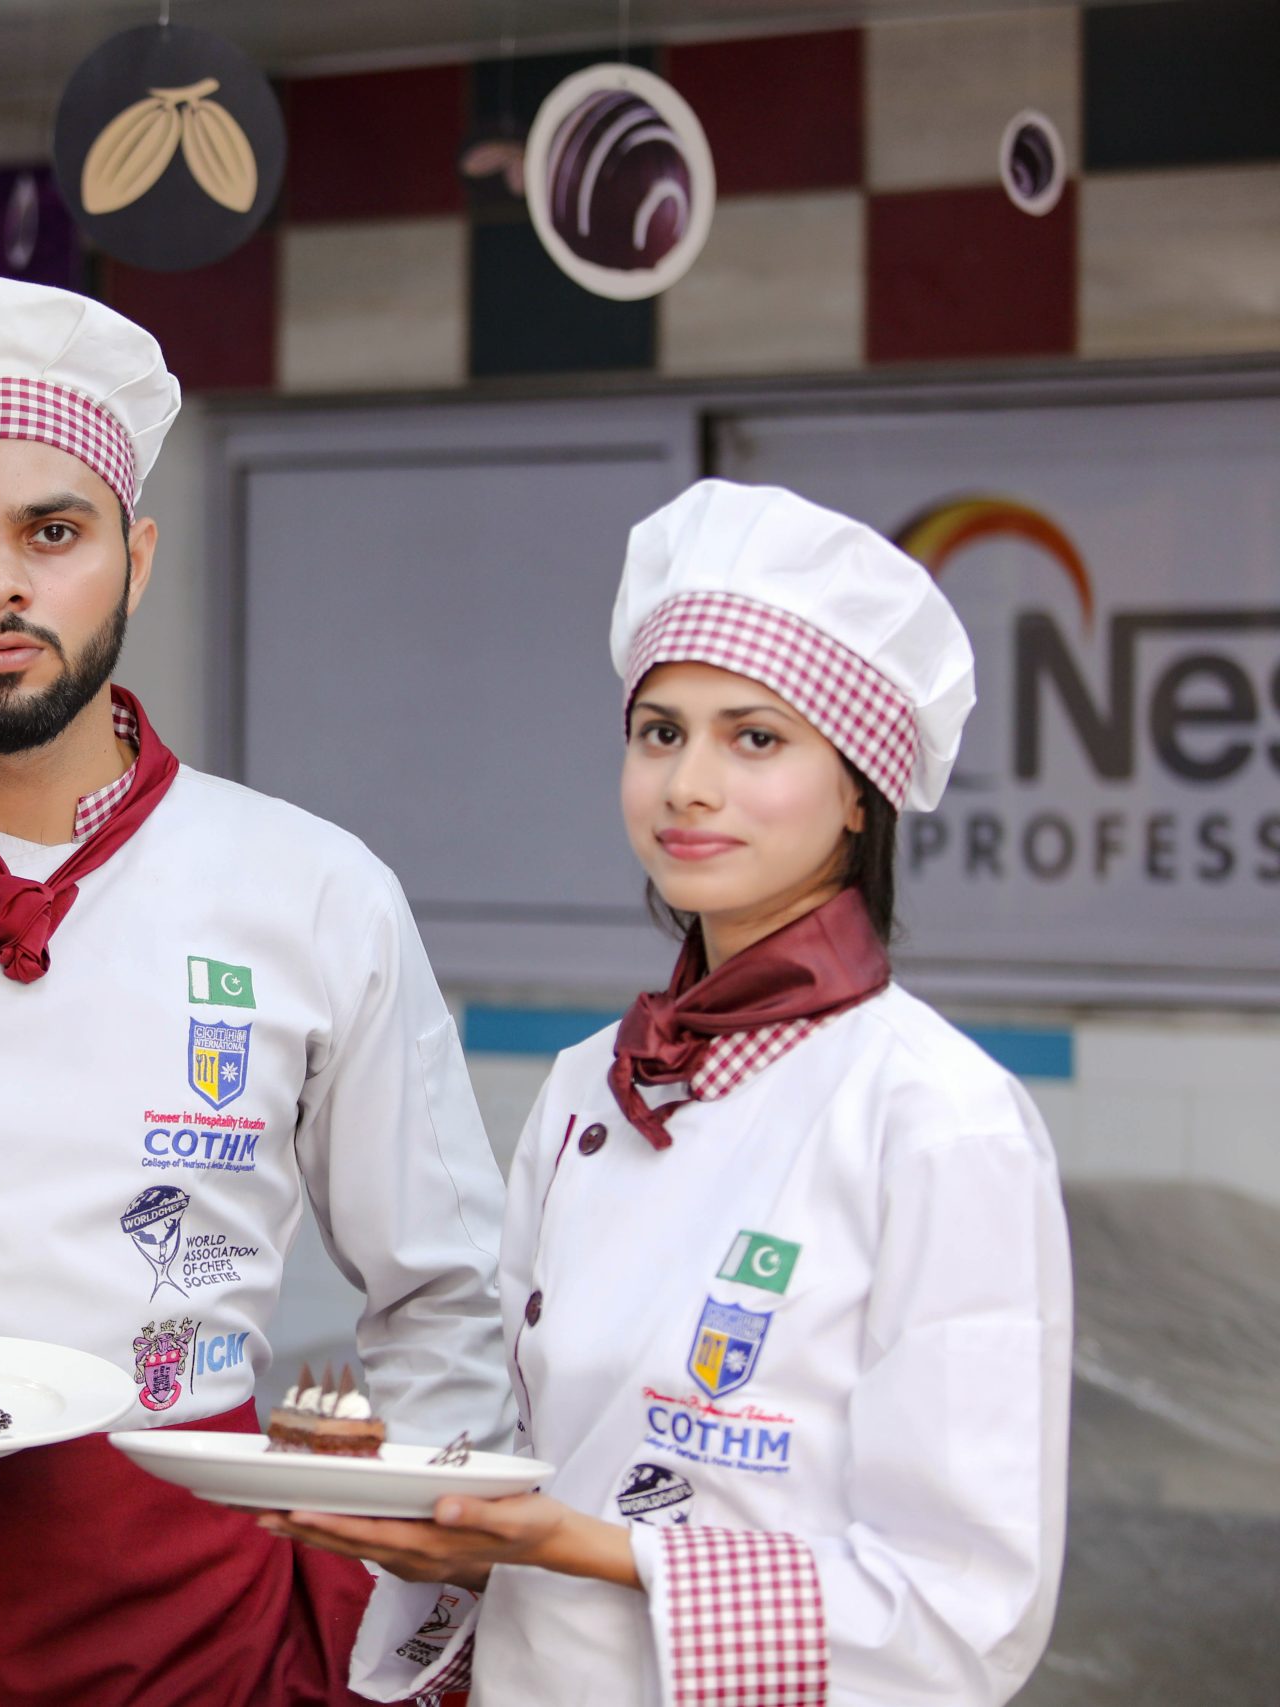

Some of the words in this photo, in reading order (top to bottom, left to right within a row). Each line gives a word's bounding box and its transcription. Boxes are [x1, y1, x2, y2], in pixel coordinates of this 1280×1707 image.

[1013, 610, 1280, 785] Ne
[144, 1110, 181, 1123] Pioneer
[183, 1111, 192, 1123] in
[194, 1113, 238, 1131] Hospitality
[238, 1116, 267, 1131] Education
[144, 1129, 261, 1161] COTHM
[142, 1157, 171, 1170] College
[172, 1158, 181, 1168] of
[123, 1199, 190, 1231] WORLDCHEFS
[186, 1235, 226, 1248] WORLD
[183, 1246, 259, 1262] ASSOCIATION
[198, 1259, 234, 1275] CHEFS
[184, 1271, 242, 1288] SOCIETIES
[196, 1331, 251, 1376] ICM
[648, 1406, 791, 1461] COTHM
